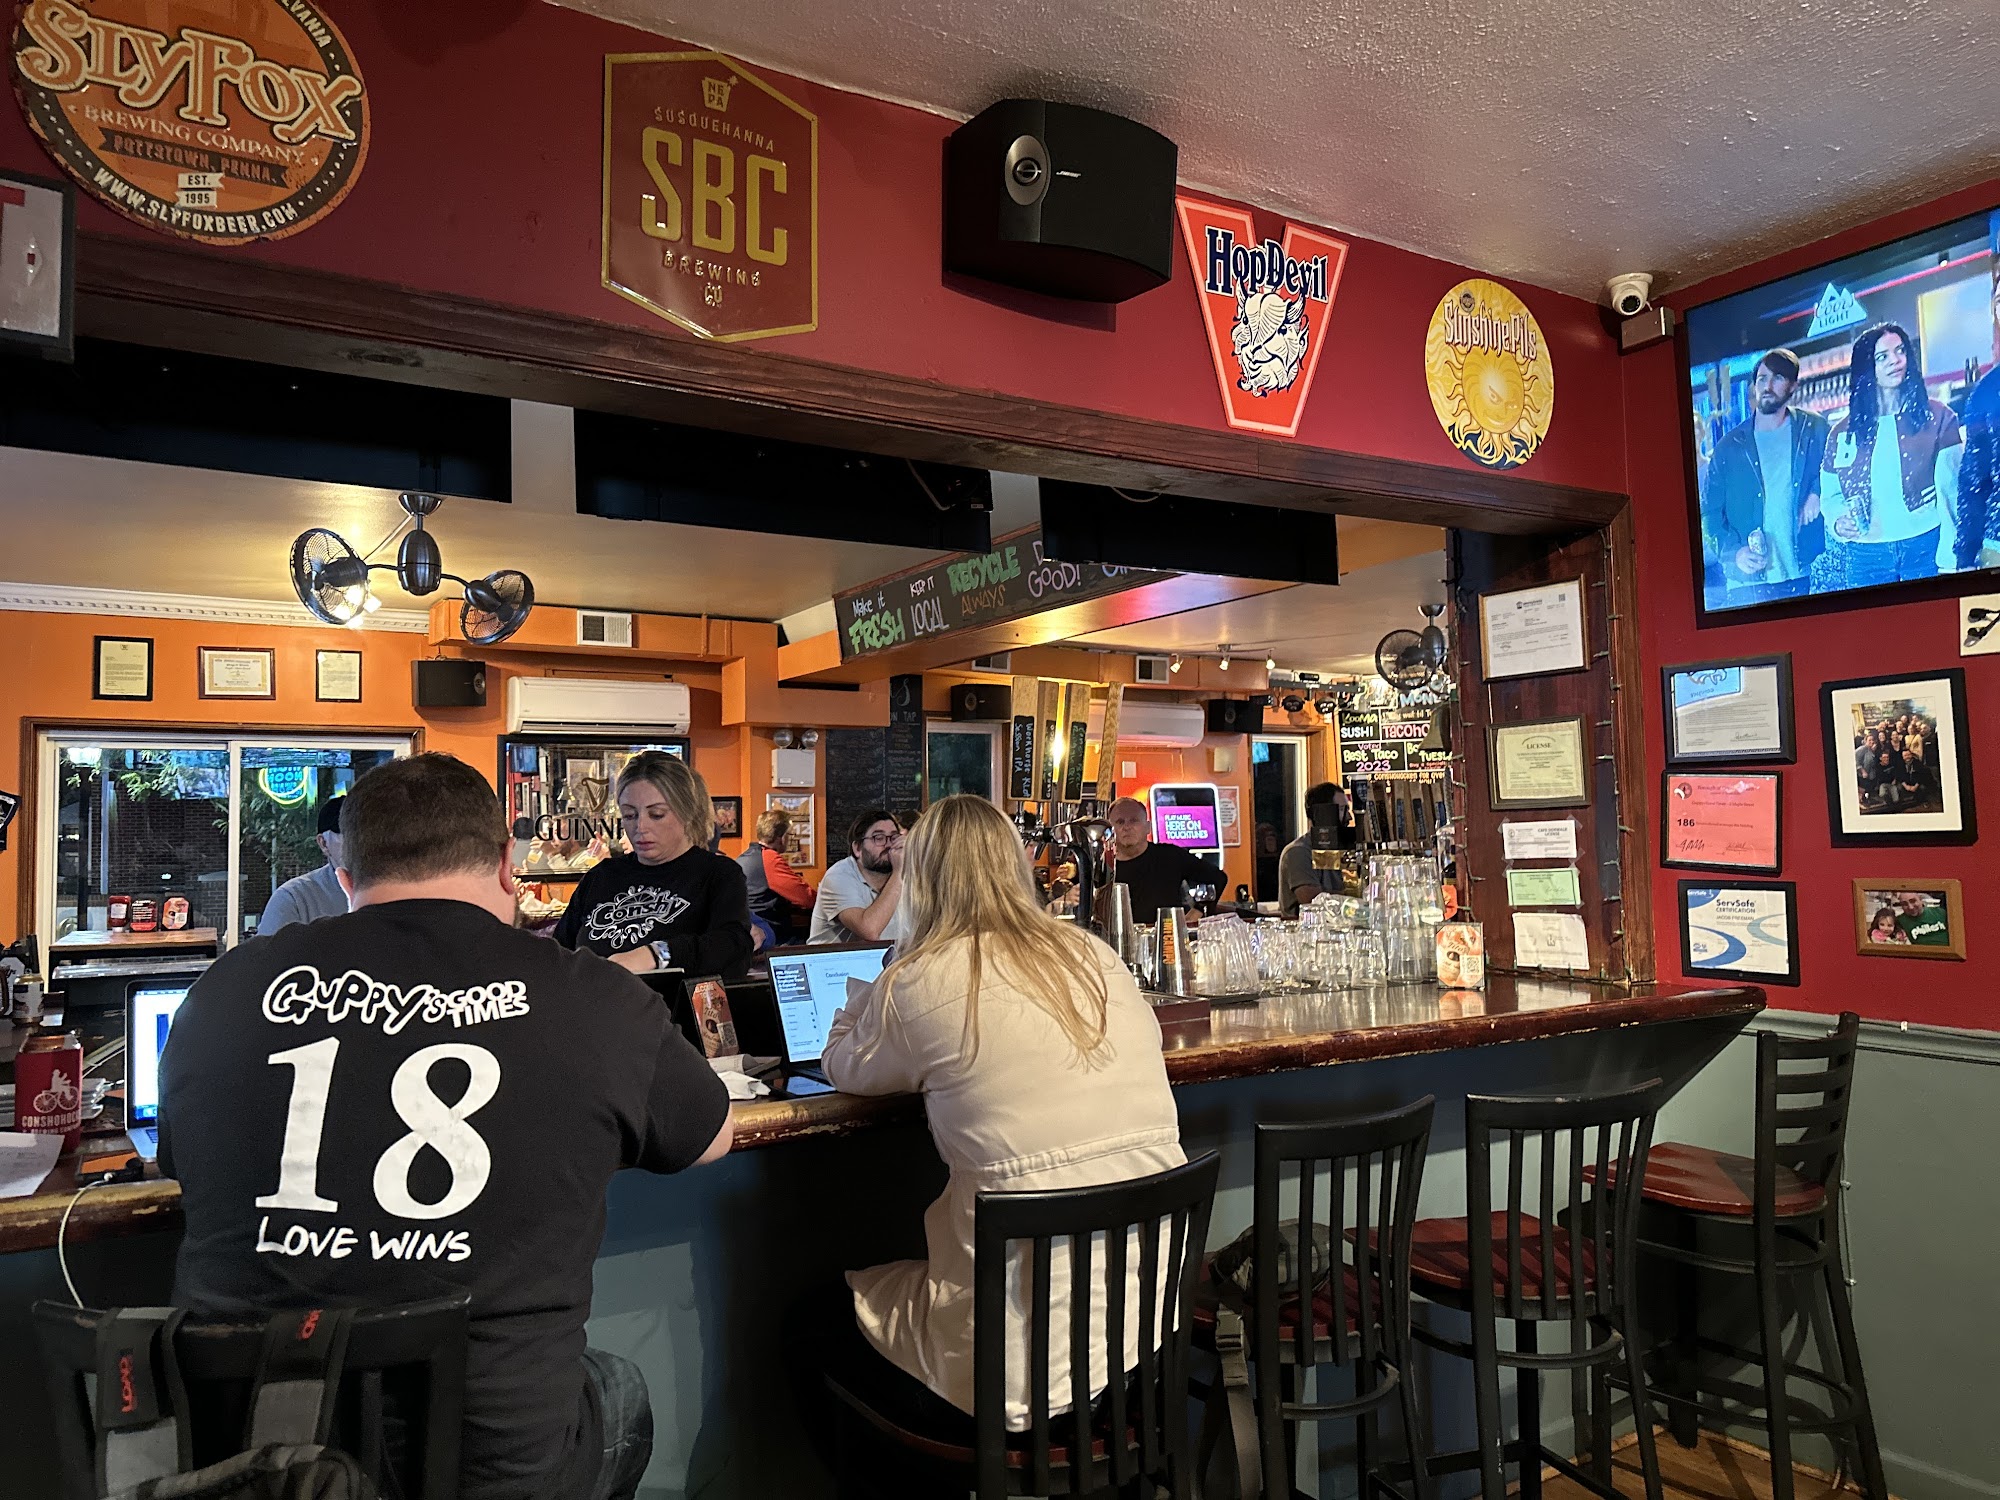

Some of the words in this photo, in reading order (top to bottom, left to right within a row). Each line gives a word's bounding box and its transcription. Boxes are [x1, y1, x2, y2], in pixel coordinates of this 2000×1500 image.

[84, 104, 190, 141] BREWING
[196, 130, 304, 165] COMPANY
[654, 107, 775, 152] SUSQUEHANNA
[187, 174, 211, 186] EST.
[93, 167, 298, 234] WWW.SLYFOXBEER.COM
[185, 193, 210, 204] 1995
[641, 126, 788, 266] SBC
[663, 250, 761, 287] BREWING
[1819, 310, 1849, 328] LIGHT
[947, 546, 1021, 597] RECYCLE
[1028, 563, 1081, 598] GOOD!
[852, 598, 873, 617] Make
[877, 591, 886, 608] it
[960, 584, 1006, 616] ALWAYS
[848, 608, 906, 655] FRESH
[910, 596, 949, 637] LOCAL
[1341, 726, 1374, 738] SUSHI
[1526, 742, 1552, 750] LICENSE
[1015, 757, 1024, 773] IPA
[1343, 749, 1368, 763] Best
[1371, 748, 1398, 760] Taco
[1356, 760, 1391, 772] 2023
[1165, 820, 1186, 831] HERE
[1186, 820, 1201, 831] ON
[1677, 818, 1695, 827] 186
[1716, 898, 1755, 907] ServSafe
[448, 980, 527, 1008] GOOD
[446, 996, 530, 1028] TIMES
[255, 1036, 501, 1220] 18
[256, 1216, 358, 1258] LOVE
[369, 1230, 471, 1262] WINS
